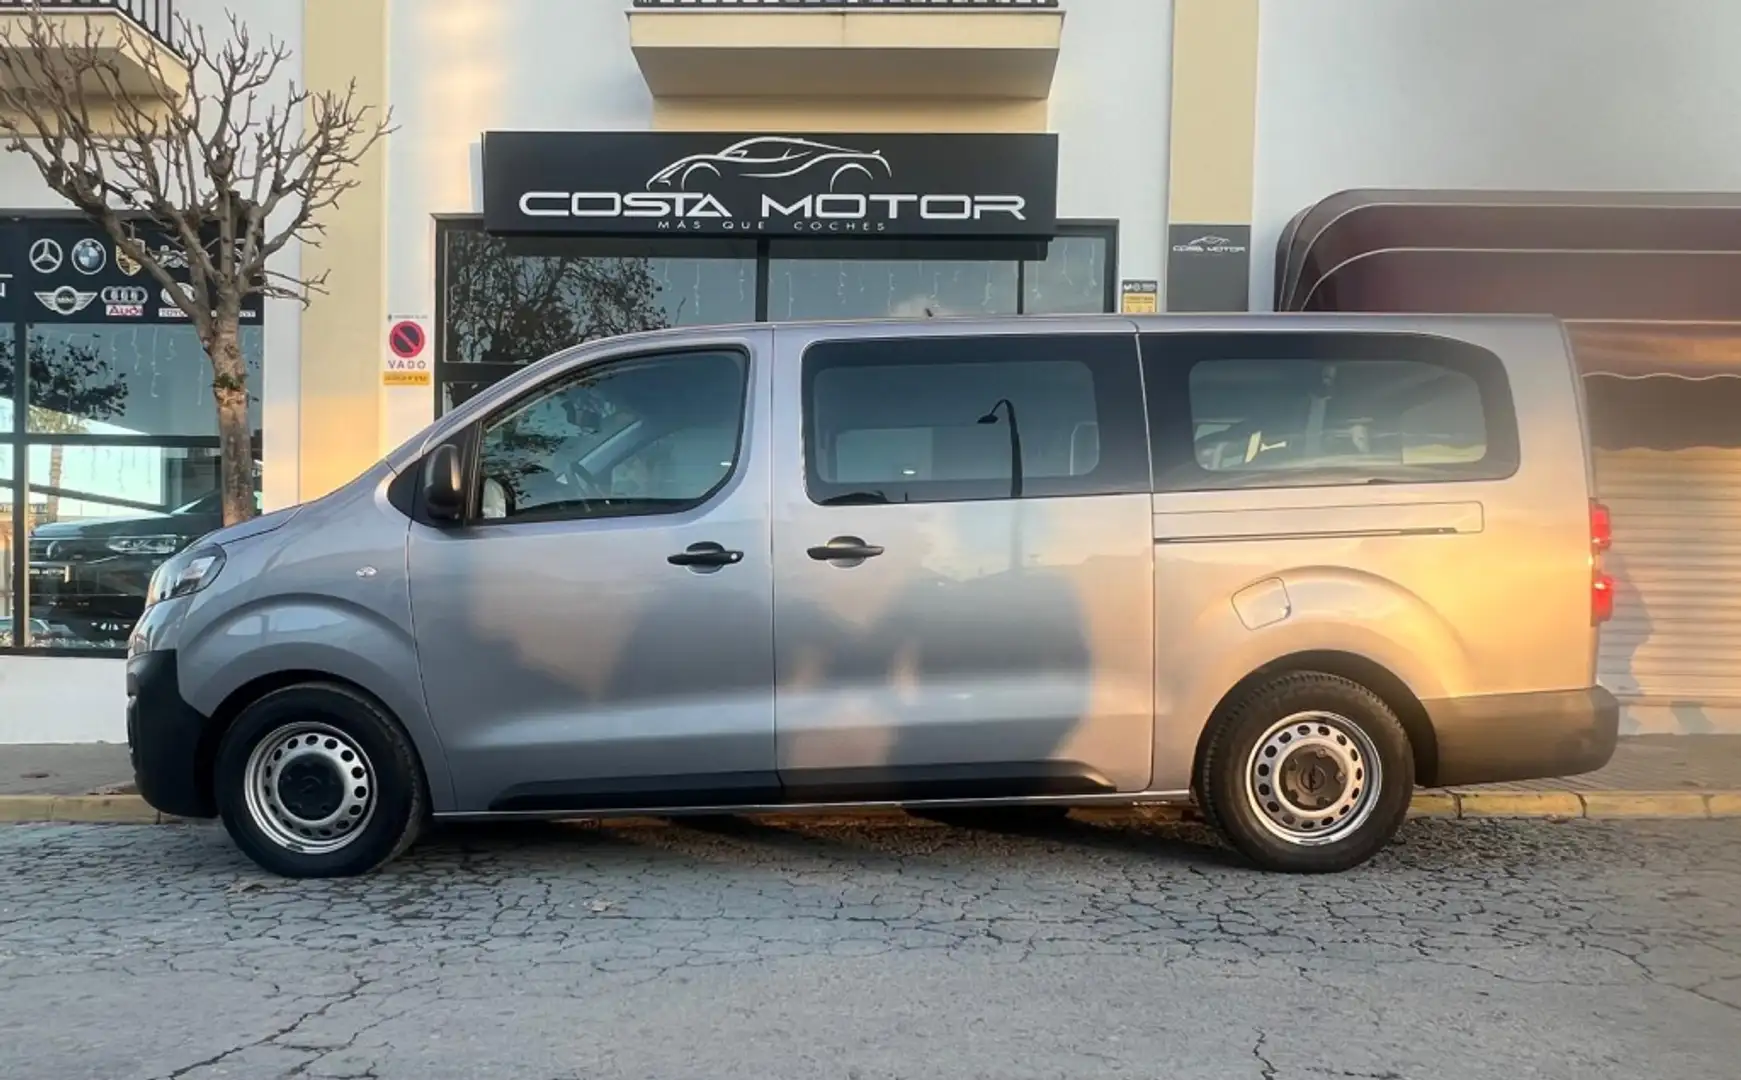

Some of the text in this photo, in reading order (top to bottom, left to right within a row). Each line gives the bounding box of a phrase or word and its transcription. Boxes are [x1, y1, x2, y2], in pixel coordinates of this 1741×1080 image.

[518, 191, 1027, 220] COSTA MOTOR
[722, 221, 765, 231] QUE
[793, 221, 886, 232] COCHES
[109, 305, 143, 316] Audi
[387, 359, 427, 370] VADO
